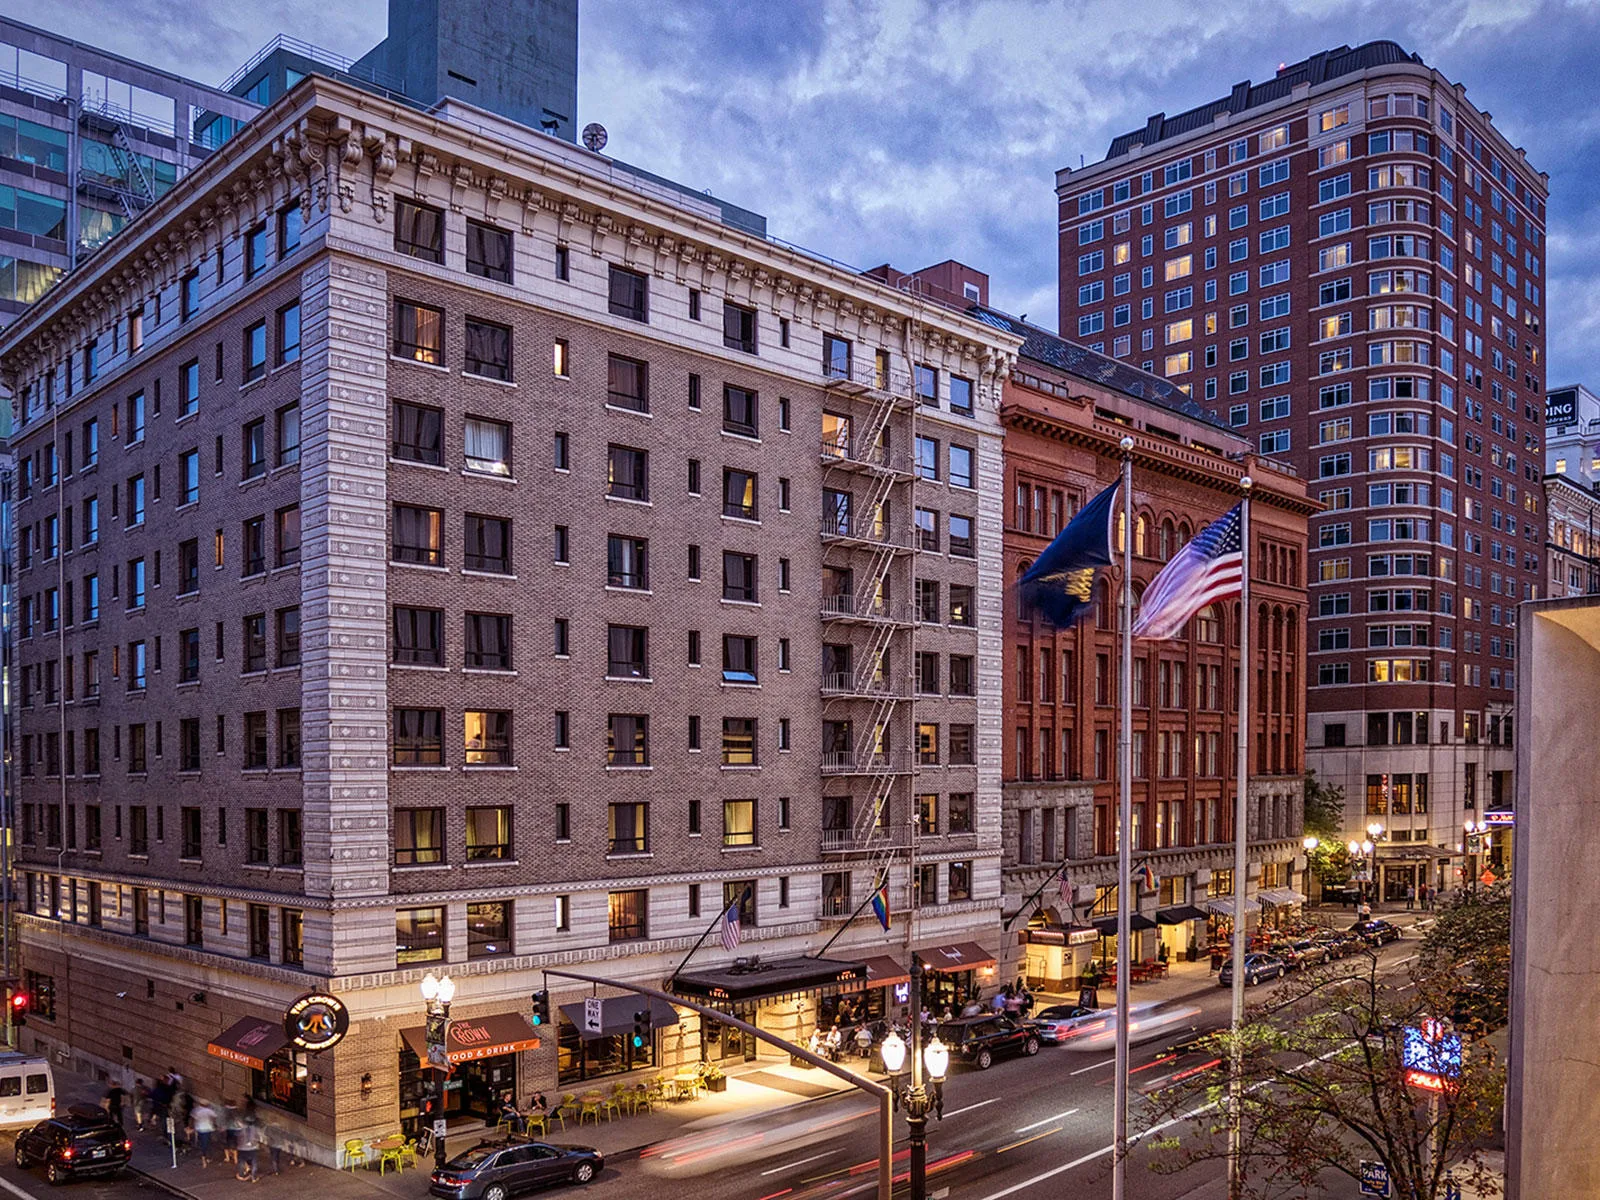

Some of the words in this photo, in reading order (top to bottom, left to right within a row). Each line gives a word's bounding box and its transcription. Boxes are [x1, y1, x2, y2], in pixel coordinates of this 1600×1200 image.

[290, 1000, 309, 1014] THE
[308, 996, 342, 1011] CROWN
[587, 1000, 599, 1010] ONE
[486, 1044, 515, 1055] DRINK
[1362, 1167, 1388, 1181] PARK
